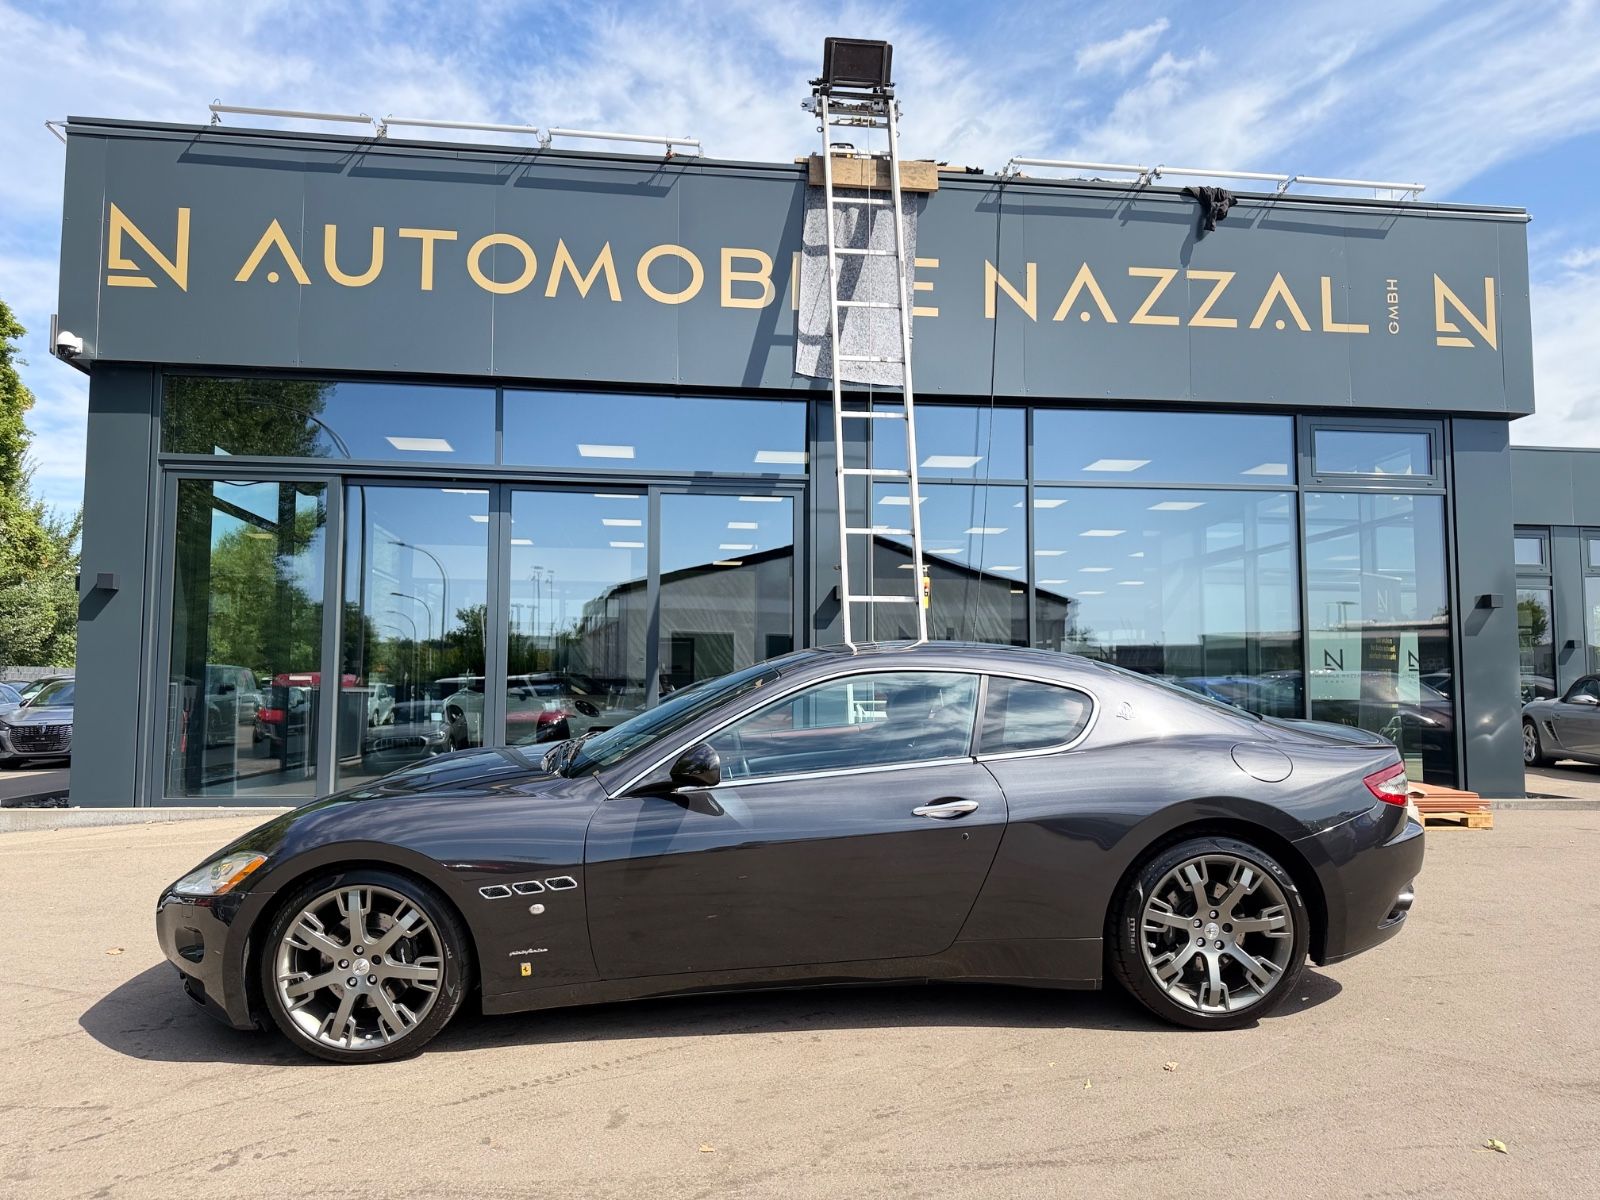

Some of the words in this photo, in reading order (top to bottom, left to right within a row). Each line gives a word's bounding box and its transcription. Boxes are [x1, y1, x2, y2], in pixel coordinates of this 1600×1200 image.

[234, 218, 940, 317] AUTOMOBIE
[984, 258, 1370, 334] NAZZAL
[1386, 279, 1400, 335] GMBH
